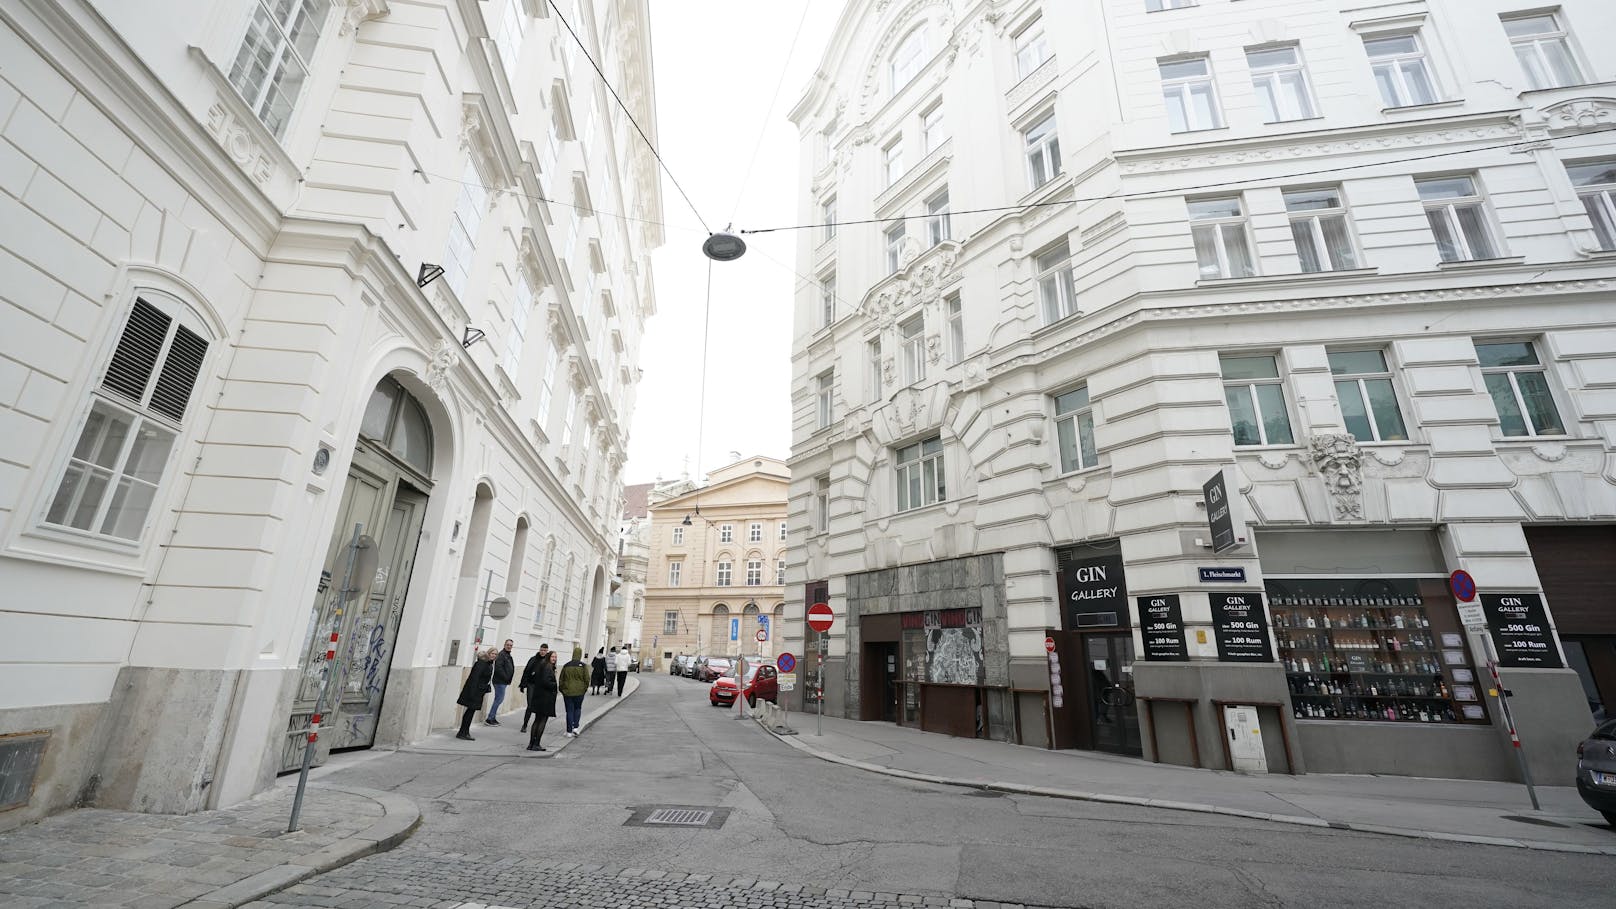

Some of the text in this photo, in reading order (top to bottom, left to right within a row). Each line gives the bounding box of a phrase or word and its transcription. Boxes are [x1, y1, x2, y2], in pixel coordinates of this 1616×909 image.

[1209, 483, 1223, 503] GIN
[1210, 503, 1228, 523] GALLERY
[1076, 565, 1107, 583] GIN
[1071, 586, 1118, 602] GALLERY
[1150, 599, 1166, 607] GIN
[1226, 596, 1245, 605] GIN
[1500, 597, 1522, 606] GIN
[925, 611, 941, 627] GIN
[966, 608, 983, 625] GIN
[1154, 622, 1165, 630] 500
[1165, 622, 1177, 630] Gin
[1230, 621, 1244, 629] 500
[1245, 621, 1259, 629] Gin
[1507, 624, 1541, 632] 500 Gin
[1155, 637, 1166, 645] 100
[1166, 637, 1180, 645] Rum
[1232, 636, 1245, 644] 100
[1246, 637, 1262, 645] Rum
[1512, 640, 1527, 648] 100
[1527, 640, 1547, 649] Rum
